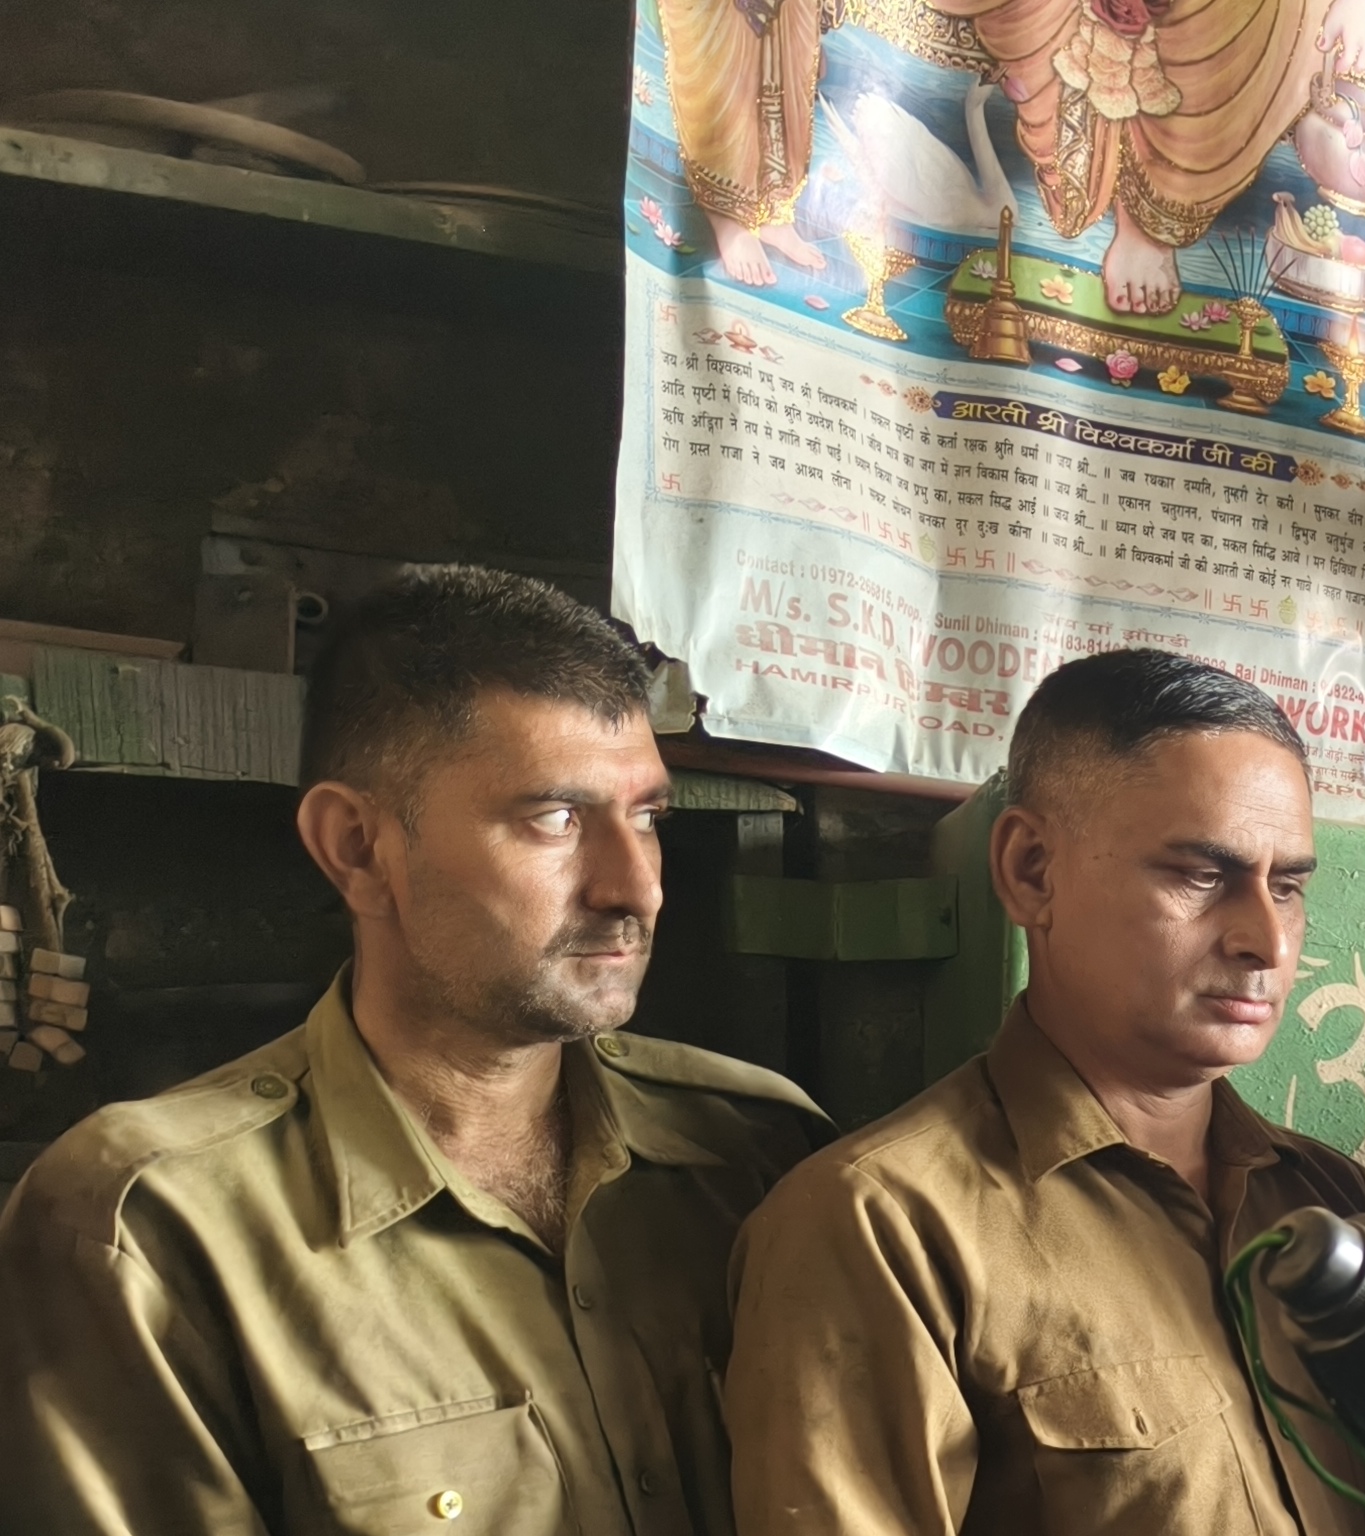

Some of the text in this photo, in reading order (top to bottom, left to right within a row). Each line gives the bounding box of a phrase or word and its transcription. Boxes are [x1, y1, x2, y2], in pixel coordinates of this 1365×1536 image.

[661, 351, 676, 366] जय
[686, 353, 699, 371] श्री
[707, 355, 753, 378] विश्वकर्मा
[759, 370, 775, 391] प्रभु
[779, 377, 794, 393] जय
[801, 383, 812, 399] श्री
[817, 388, 857, 414] विश्वकर्मा
[920, 426, 931, 445] के
[963, 438, 988, 453] रक्षक
[995, 440, 1014, 460] श्रुति
[1056, 454, 1071, 469] जय
[662, 379, 685, 398] आदि
[723, 384, 731, 403] में
[737, 387, 759, 408] विधि
[765, 396, 778, 414] को
[784, 403, 801, 424] श्रुति
[806, 411, 833, 432] उपदेश
[838, 419, 856, 440] दिया
[903, 453, 915, 467] का
[919, 458, 935, 473] जग
[941, 457, 949, 475] में
[954, 464, 971, 479] ज्ञान
[977, 462, 1008, 481] विकास
[1015, 470, 1038, 488] किया
[1055, 480, 1070, 495] जय
[952, 400, 1277, 475] आरती श्री विश्वकर्मा जी की
[662, 408, 684, 424] ऋषि
[730, 415, 738, 431] ने
[744, 421, 757, 435] तप
[764, 421, 773, 439] से
[914, 484, 929, 504] प्रभु
[957, 491, 983, 506] सकल
[1019, 497, 1037, 515] आई
[1054, 506, 1069, 523] जय
[662, 432, 679, 453] रोग
[689, 441, 710, 457] ग्रस्त
[720, 444, 743, 461] राजा
[752, 447, 760, 465] ने
[769, 455, 785, 471] जब
[795, 462, 823, 481] आश्रय
[831, 472, 851, 490] लीना
[919, 512, 946, 529] बनकर
[956, 518, 968, 536] दूर
[1008, 521, 1031, 539] कीना
[1053, 533, 1068, 549] जय
[1118, 495, 1151, 512] एकानन
[1211, 507, 1242, 527] पंचानन
[1252, 514, 1268, 531] राजे
[1120, 468, 1135, 483] जब
[1145, 473, 1175, 488] रथकार
[1256, 488, 1268, 502] टेर
[1276, 494, 1294, 511] करी
[1314, 504, 1340, 522] सुनकर
[1348, 508, 1363, 526] दीन
[1115, 543, 1126, 559] श्री
[1132, 545, 1173, 568] विश्वकर्मा
[1179, 553, 1190, 569] जी
[1195, 554, 1208, 573] की
[1213, 561, 1238, 578] आरती
[1243, 564, 1254, 581] जो
[1259, 568, 1276, 587] कोई
[1281, 575, 1291, 588] नर
[1116, 521, 1136, 535] ध्यान
[1142, 521, 1154, 538] धरे
[1161, 528, 1176, 541] जब
[1182, 531, 1194, 544] पद
[1223, 538, 1247, 554] सकल
[1282, 547, 1300, 564] आवे
[1313, 556, 1326, 570] मन
[737, 549, 795, 577] Contact
[935, 613, 970, 632] Sunil
[976, 617, 1029, 639] Dhiman
[740, 577, 811, 623] M/s.
[735, 620, 887, 681] धीमान
[1236, 663, 1255, 684] Raj
[1260, 669, 1308, 692] Dhiman
[918, 715, 1003, 742] OAD,
